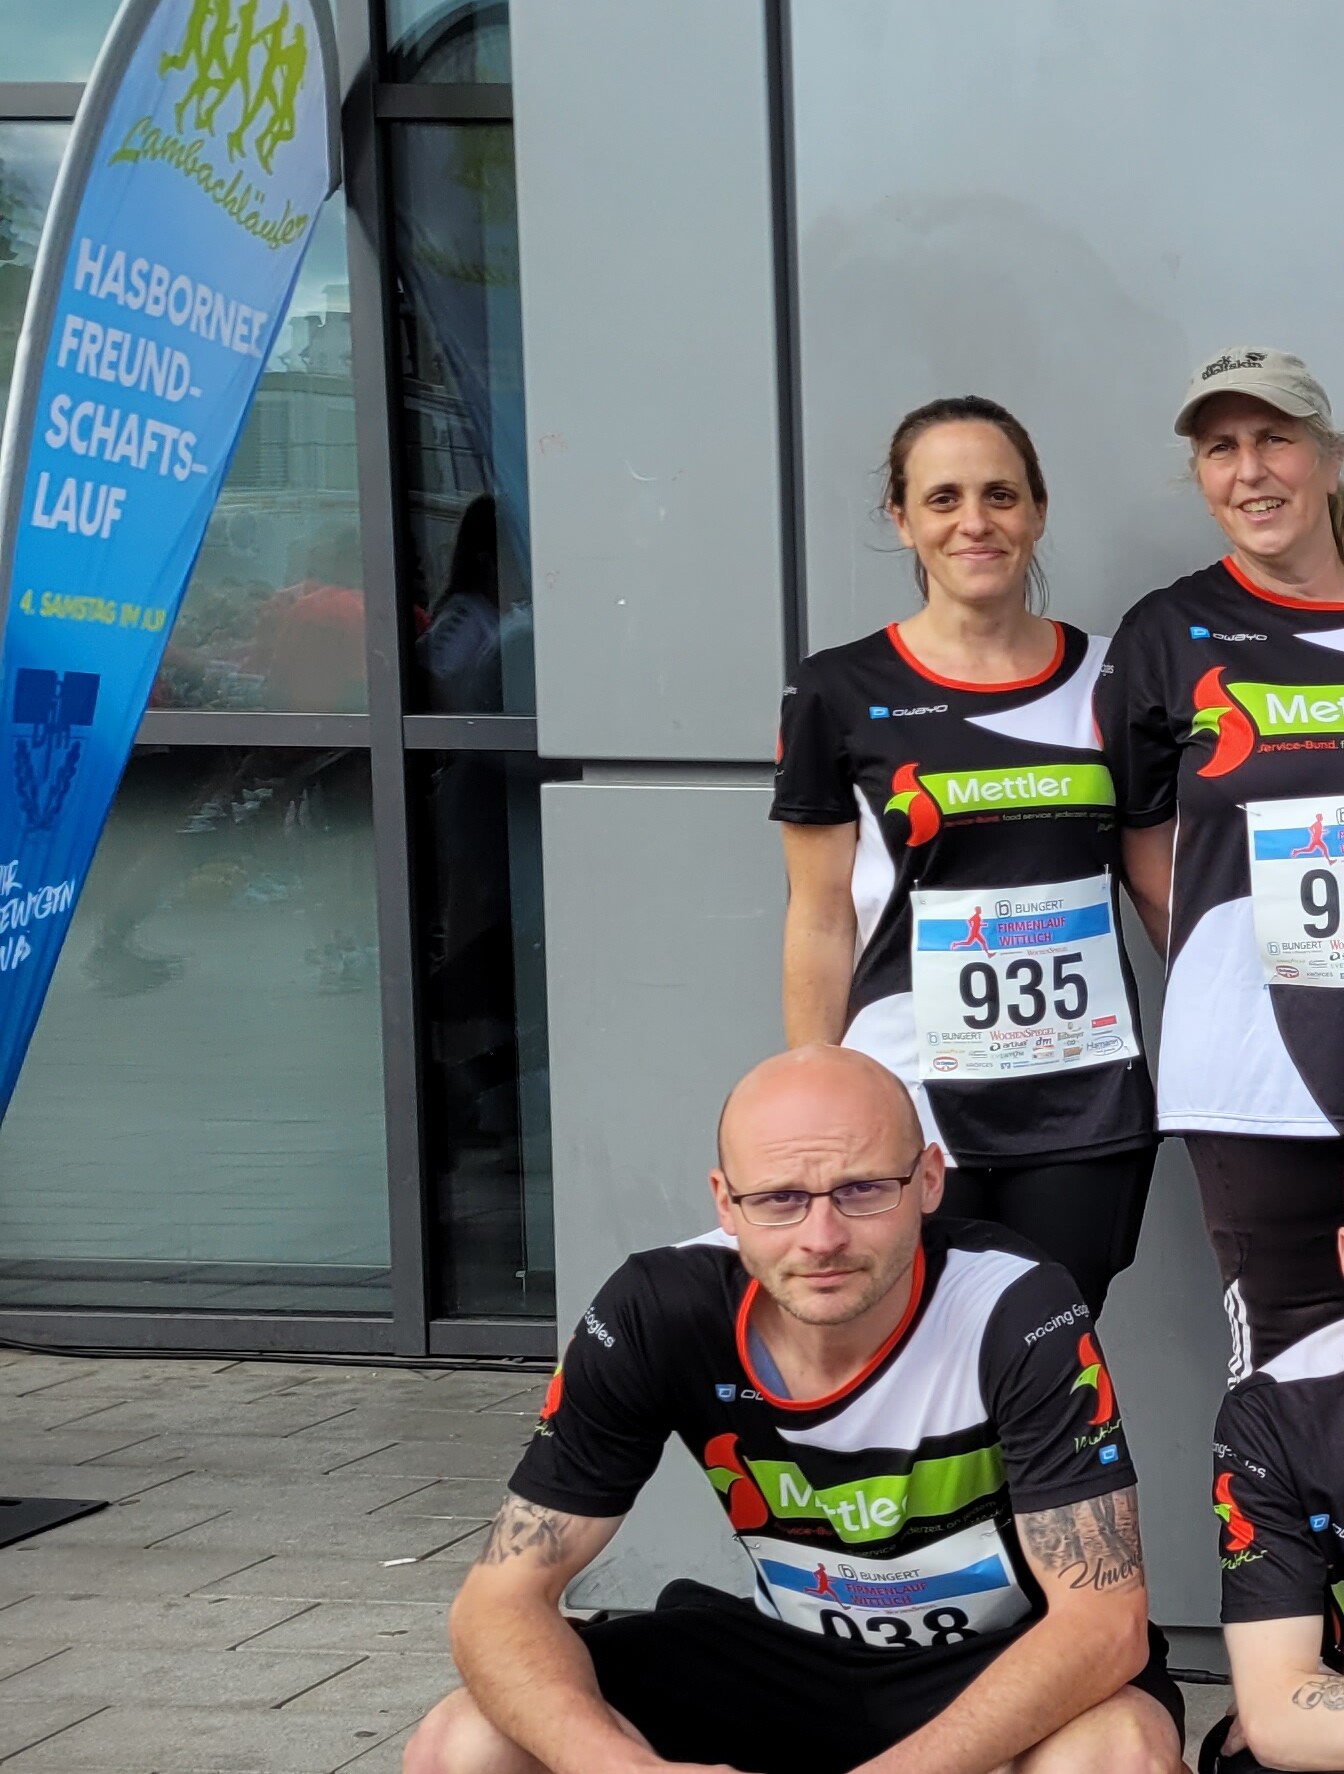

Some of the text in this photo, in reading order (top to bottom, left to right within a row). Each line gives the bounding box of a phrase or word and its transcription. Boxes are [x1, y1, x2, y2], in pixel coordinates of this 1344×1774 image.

[57, 315, 203, 403] FREUND-
[45, 394, 207, 481] SCHAFTS-
[31, 471, 126, 539] LAUF
[1212, 632, 1268, 642] owayo
[892, 704, 949, 717] owayo
[947, 773, 1072, 805] Mettler
[1016, 900, 1064, 914] BUNGERT
[997, 917, 1066, 932] FIRMENLAUF
[1000, 934, 1052, 946] WITTLICH
[1282, 941, 1322, 950] BUNGERT
[959, 952, 1088, 1029] 935
[942, 1032, 982, 1041] BUNGERT
[1024, 1311, 1075, 1347] Racing
[860, 1569, 920, 1581] BUNGERT
[846, 1583, 926, 1596] FIRMENLAUF
[852, 1596, 912, 1607] WITTLICH
